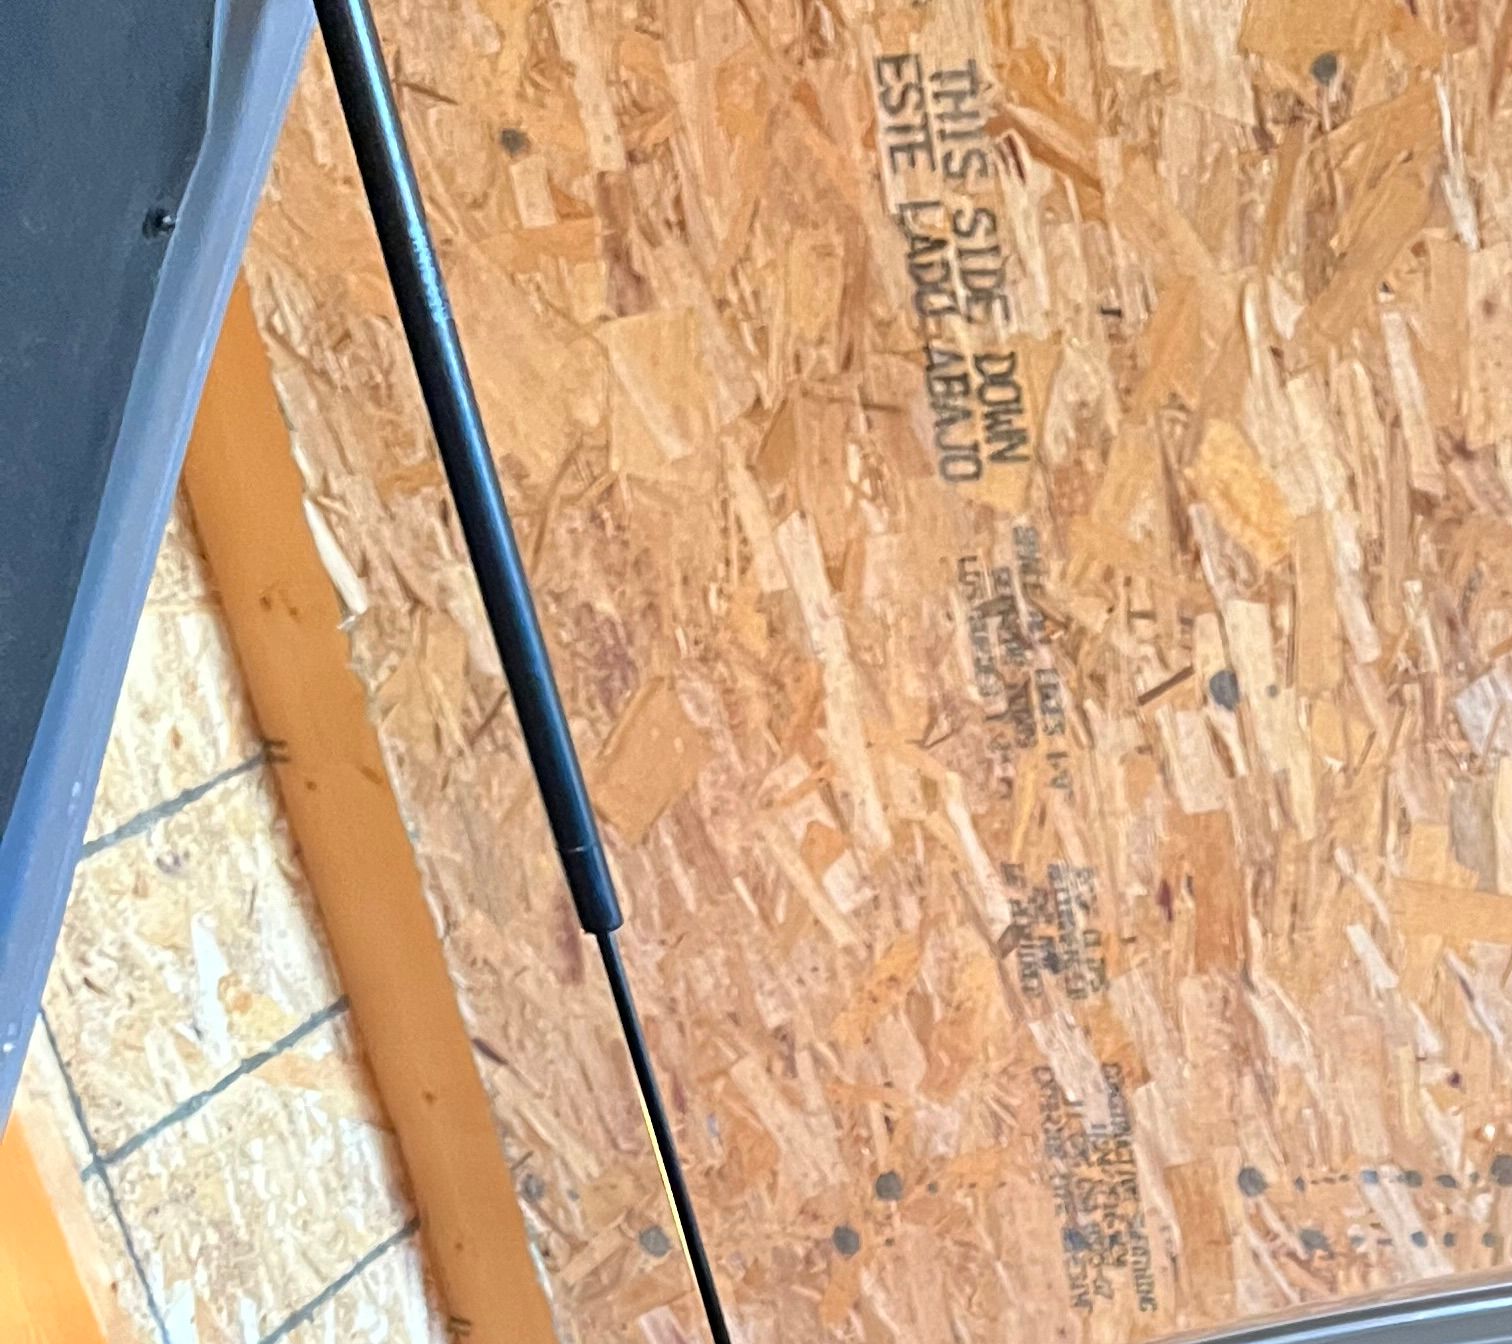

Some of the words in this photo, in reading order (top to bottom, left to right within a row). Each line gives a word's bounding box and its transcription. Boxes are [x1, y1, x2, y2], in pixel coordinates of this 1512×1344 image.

[875, 54, 936, 172] ESTE
[930, 59, 989, 179] THIS
[897, 201, 962, 319] LADO
[952, 208, 1011, 324] SIDE
[924, 343, 983, 483] ABAJO
[973, 352, 1029, 464] DOWN
